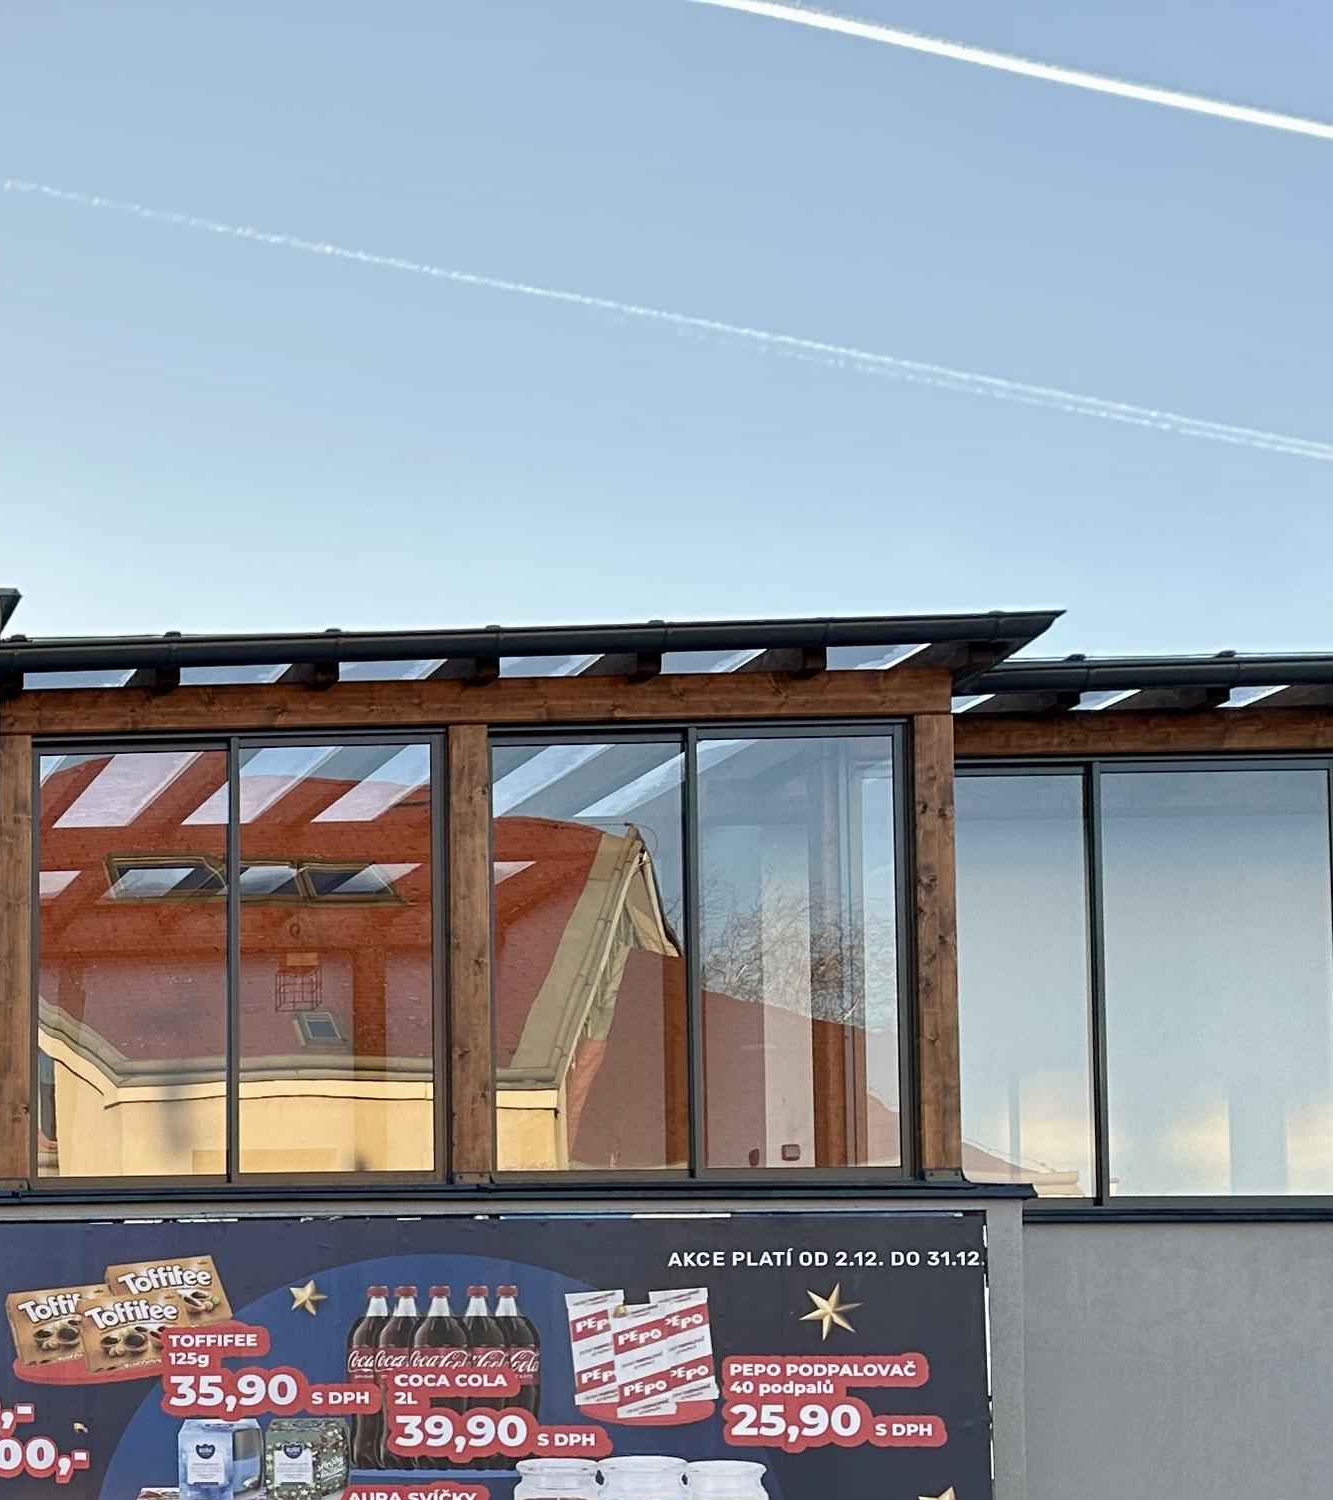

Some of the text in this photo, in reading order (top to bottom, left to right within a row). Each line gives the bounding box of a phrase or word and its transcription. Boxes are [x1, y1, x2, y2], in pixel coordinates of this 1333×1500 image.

[667, 1248, 986, 1267] AKCE PLATÍ OD 2.12. DO 31.12.
[117, 1264, 213, 1295] Toffifee
[84, 1299, 179, 1330] Toffifee
[168, 1333, 258, 1347] TOFFIFEE
[618, 1328, 663, 1346] PEPO
[169, 1352, 210, 1367] 125g
[730, 1361, 918, 1377] PEPO PODPALOVAČ
[394, 1373, 508, 1387] COCA COLA
[623, 1380, 668, 1397] PEPO
[730, 1379, 834, 1397] 40 podpalů
[168, 1373, 370, 1412] 35,90 S DPH
[394, 1392, 418, 1405] 2L
[729, 1404, 933, 1443] 25,90 S DPH
[395, 1414, 596, 1453] 39,90 S DPH
